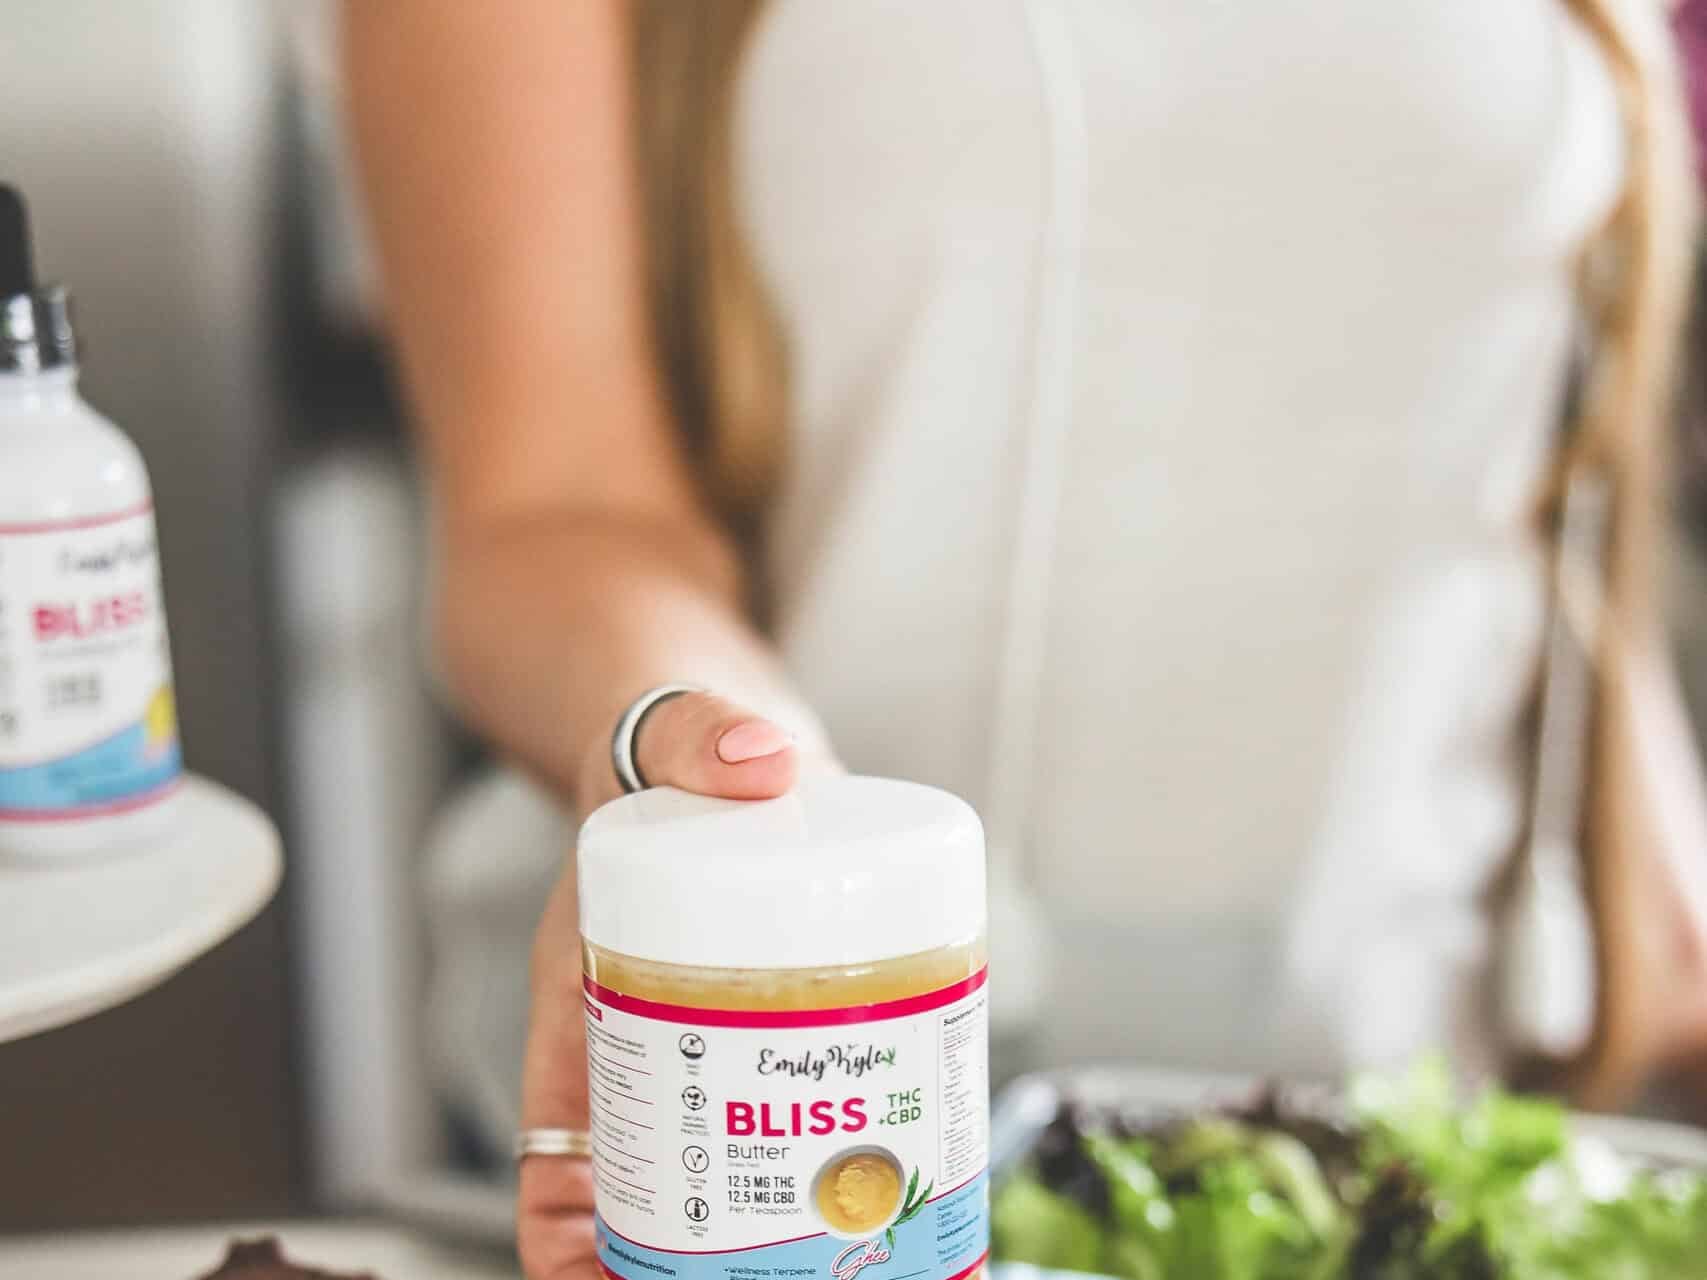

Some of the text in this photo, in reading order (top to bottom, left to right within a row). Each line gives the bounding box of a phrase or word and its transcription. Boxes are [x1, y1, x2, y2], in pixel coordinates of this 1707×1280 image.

[757, 1044, 883, 1081] Emily Kyle
[887, 1088, 922, 1109] THC
[725, 1097, 869, 1138] BLISS
[727, 1144, 791, 1160] Butter
[728, 1175, 796, 1189] 12.5 MG THC
[728, 1190, 796, 1204] 12.5 MG CBD
[749, 1206, 803, 1216] Teaspoon
[774, 1267, 816, 1276] Terpene
